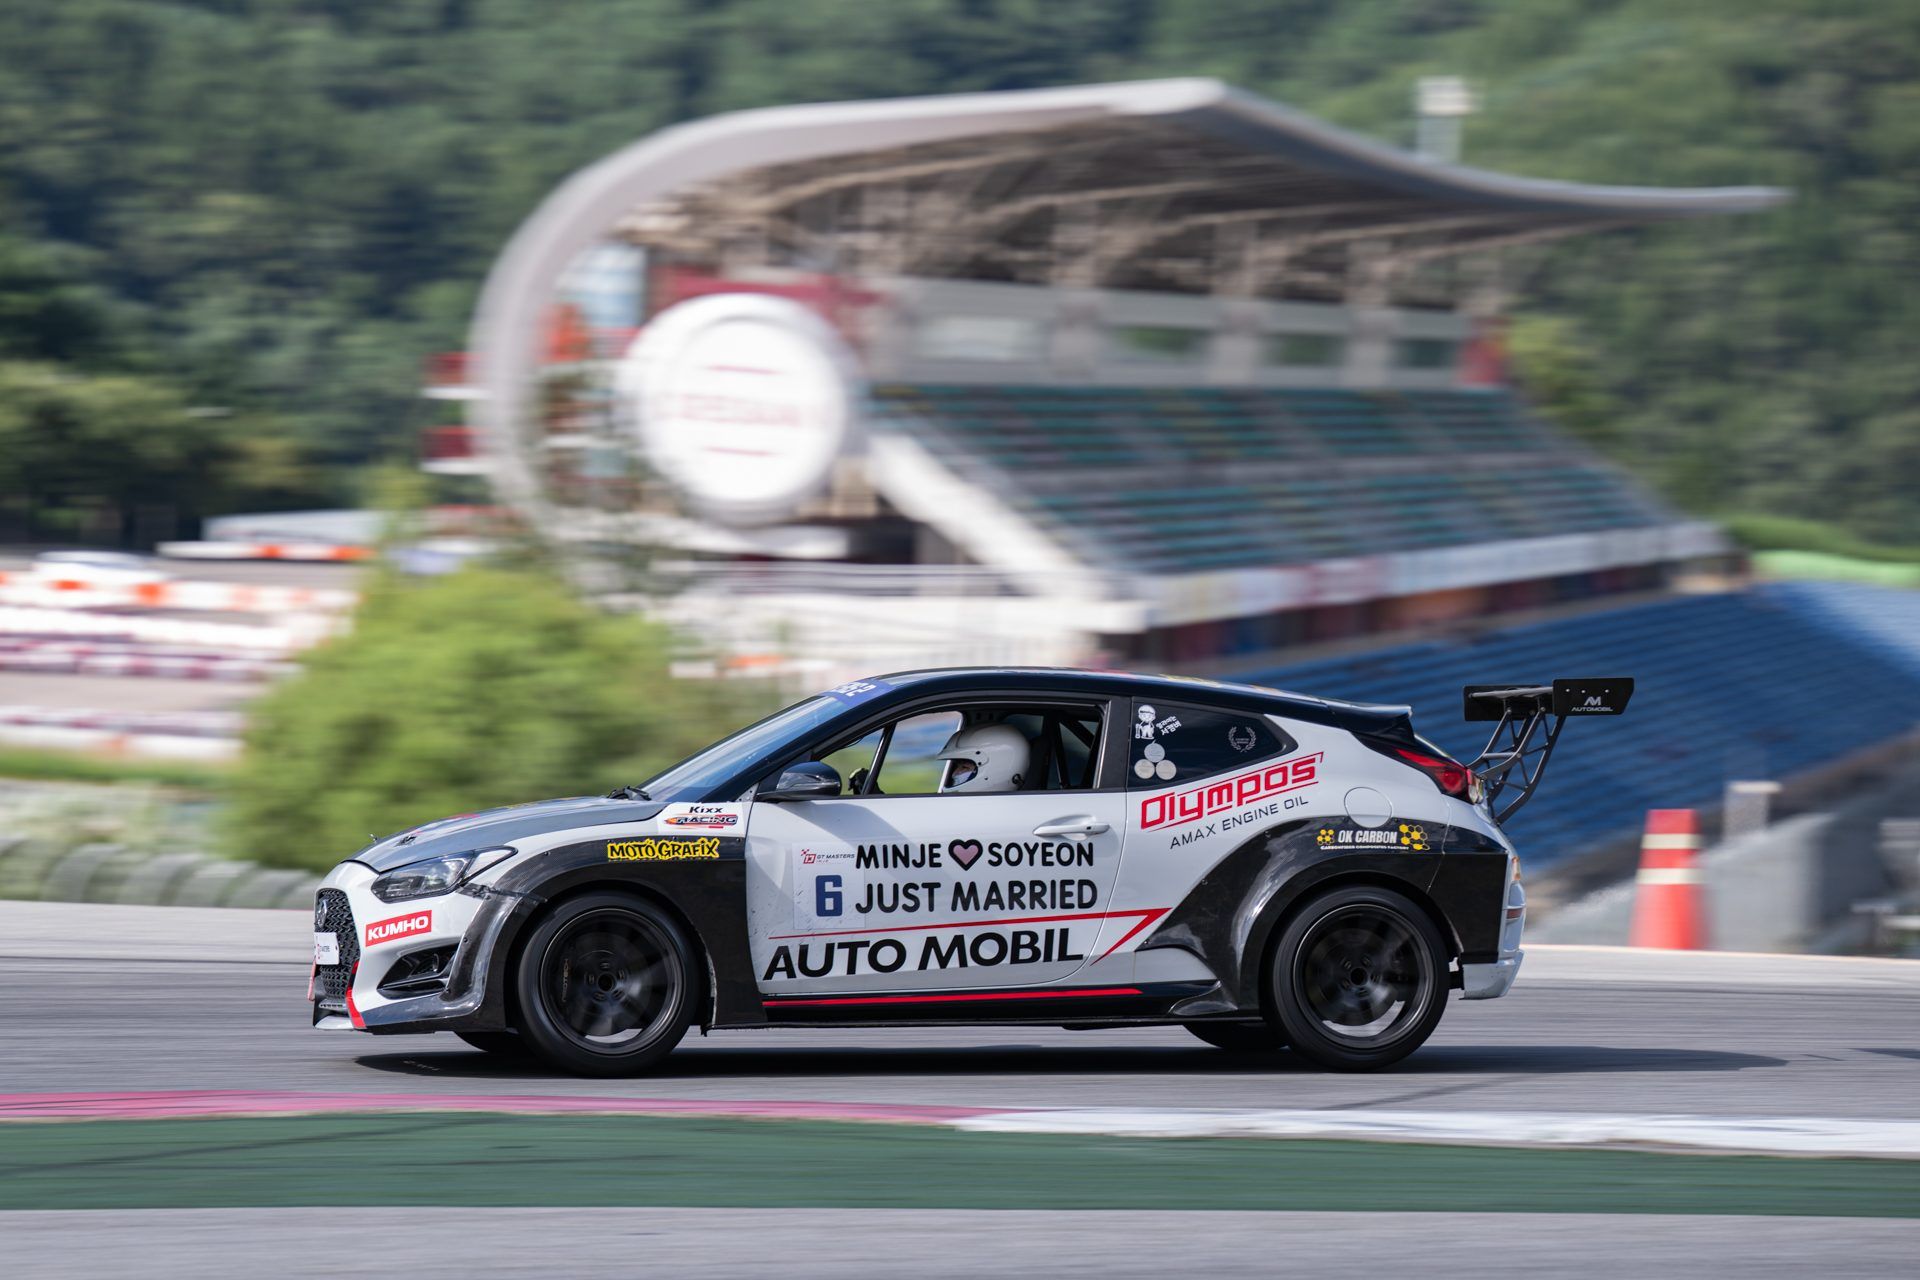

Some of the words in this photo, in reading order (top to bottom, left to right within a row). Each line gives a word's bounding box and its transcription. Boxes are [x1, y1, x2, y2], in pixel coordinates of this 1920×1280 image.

[676, 815, 738, 825] RACING
[689, 806, 724, 814] Kixx
[1169, 823, 1217, 850] AMAX
[1222, 803, 1279, 832] ENGINE
[1284, 795, 1309, 809] OIL
[1338, 830, 1353, 843] OK
[1355, 830, 1397, 844] CARBON
[855, 843, 942, 869] MINJE
[987, 842, 1094, 867] SOYEON
[815, 875, 843, 917] 6
[855, 882, 942, 914] JUST
[951, 879, 1098, 912] MARRIED
[368, 916, 428, 941] KUMHO
[763, 939, 907, 980] AUTO
[917, 928, 1084, 971] MOBIL
